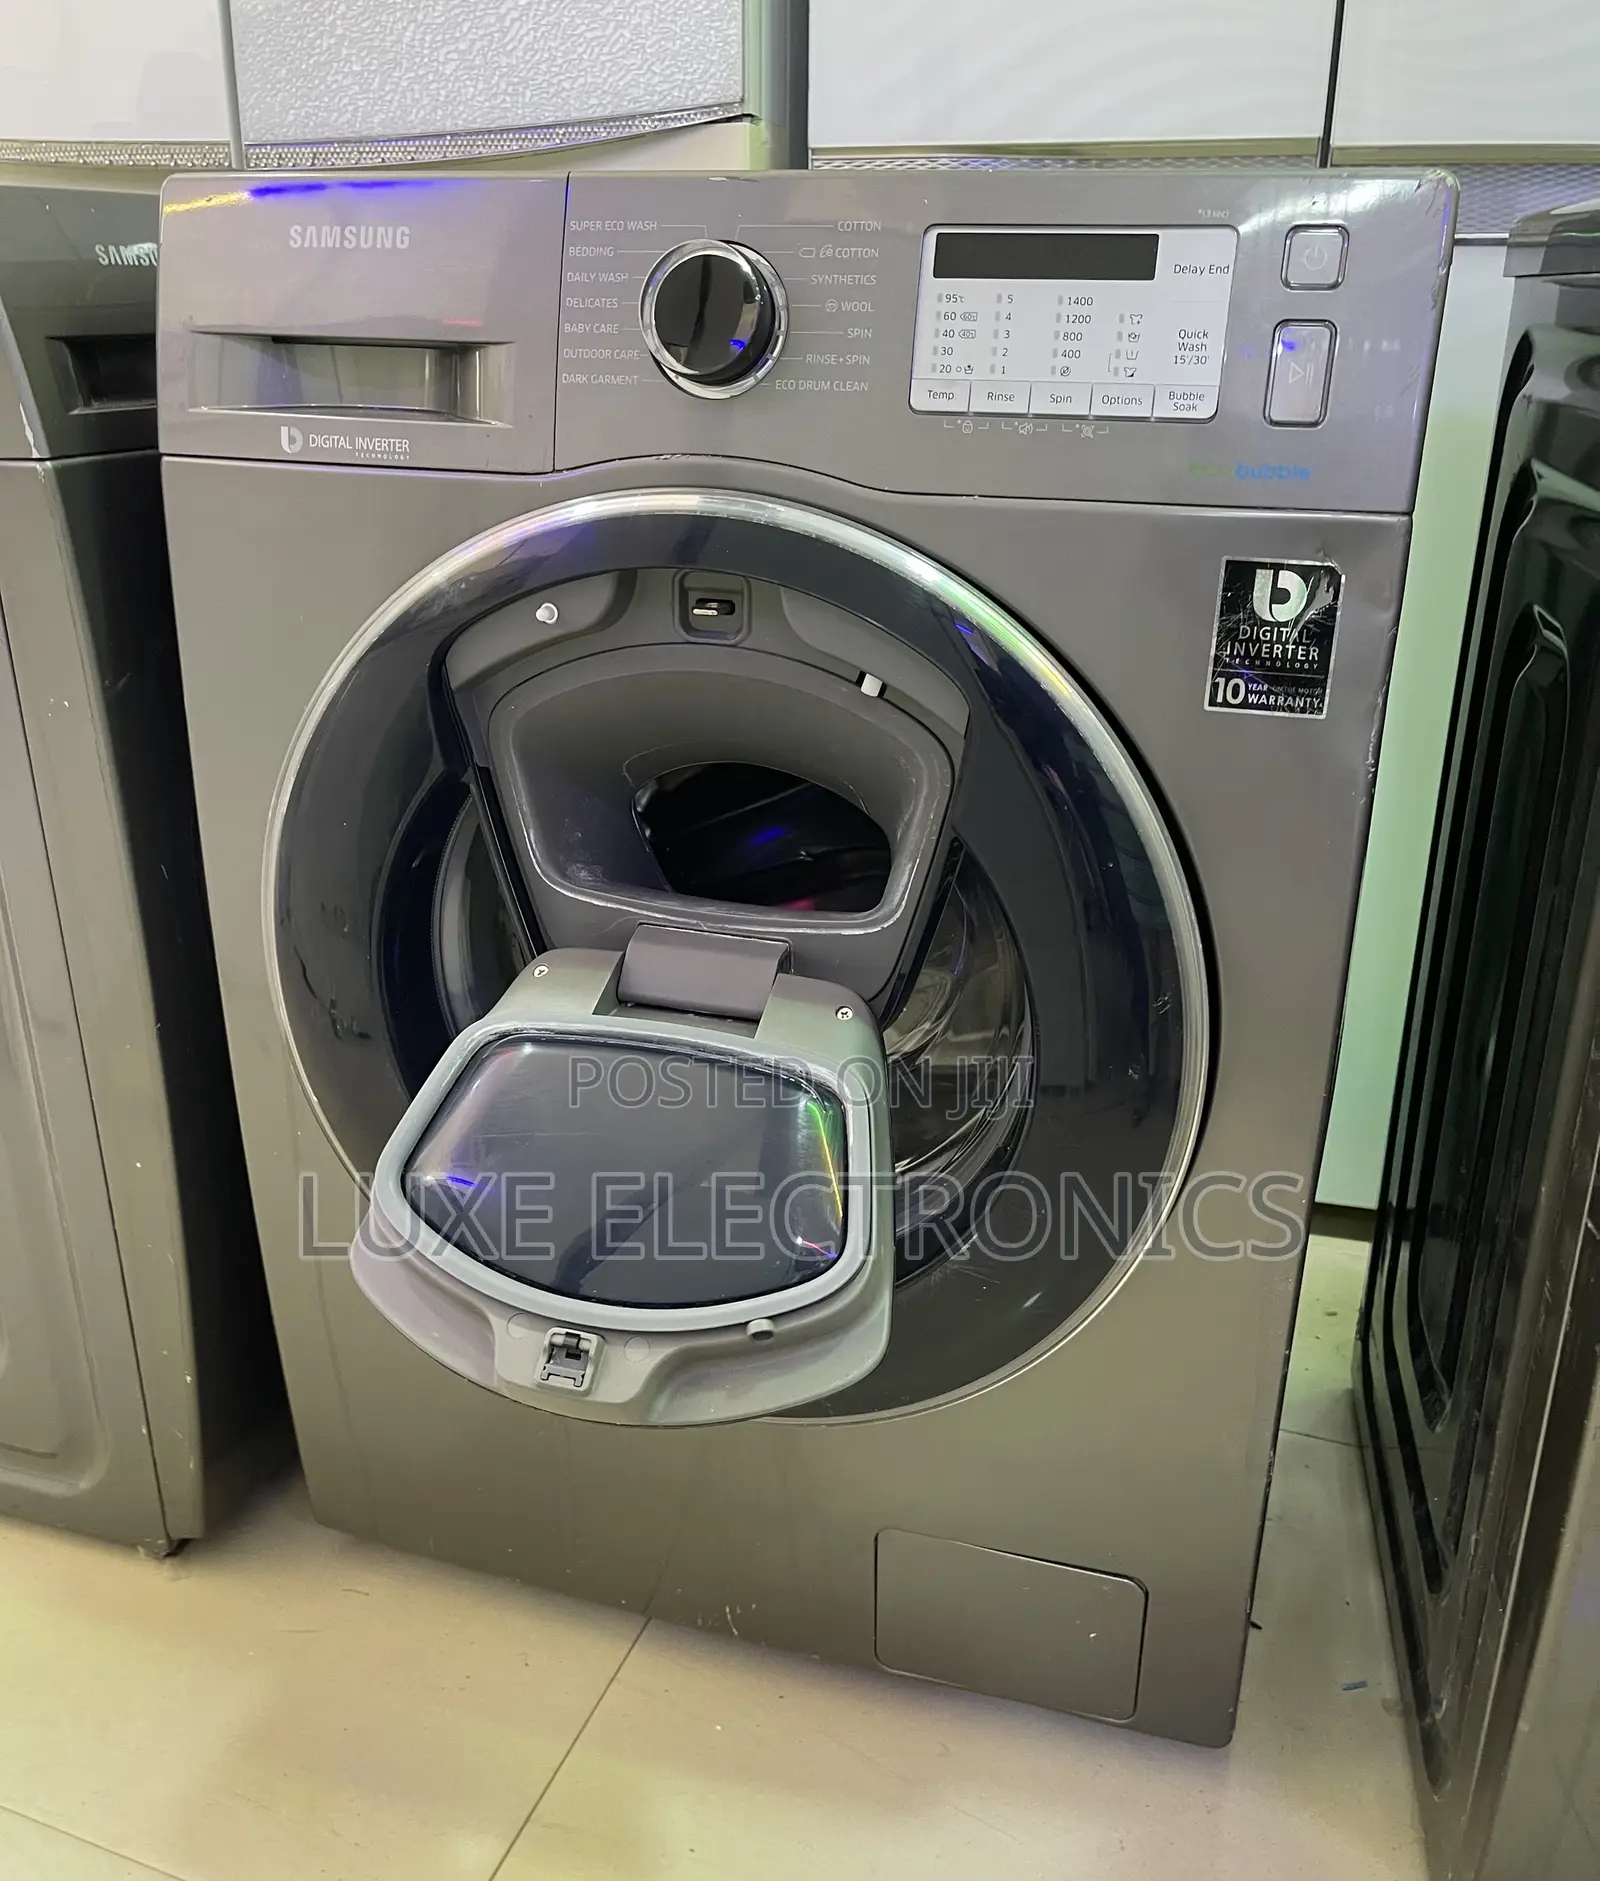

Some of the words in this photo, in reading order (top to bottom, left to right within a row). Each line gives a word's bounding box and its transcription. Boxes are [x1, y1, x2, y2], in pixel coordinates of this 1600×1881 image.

[570, 221, 602, 231] SUPER
[605, 221, 624, 231] ECO
[627, 221, 657, 231] WASH
[838, 221, 881, 231] COTTON
[289, 225, 410, 249] SAMSUNG
[569, 247, 614, 257] BEDDING
[835, 248, 879, 258] COTTON
[1173, 264, 1205, 275] Delay
[1209, 264, 1229, 274] End
[567, 273, 596, 282] DAILY
[599, 273, 628, 282] WASH
[811, 275, 877, 285] SYNTHETICS
[566, 298, 618, 308] DELICATES
[1007, 294, 1014, 303] 5
[1067, 296, 1093, 306] 1400
[841, 302, 874, 312] WOOL
[943, 312, 957, 321] 60
[1005, 312, 1012, 321] 4
[1065, 314, 1091, 324] 1200
[564, 323, 591, 333] BABY
[593, 324, 619, 333] CARE
[847, 328, 872, 338] SPIN
[942, 329, 955, 339] 40
[1004, 330, 1010, 339] 3
[1062, 332, 1083, 342] 800
[1178, 329, 1209, 340] Quick
[940, 347, 954, 356] 30
[1178, 342, 1207, 351] Wash
[563, 349, 611, 359] OUTDOOR
[614, 350, 640, 359] CARE
[1002, 348, 1009, 357] 2
[1061, 349, 1081, 359] 400
[806, 354, 870, 365] RINSE+SPIN
[939, 364, 952, 374] 20
[1001, 366, 1006, 375] 1
[562, 374, 589, 384] DARK
[591, 375, 638, 385] GARMENT
[775, 380, 795, 390] ECO
[798, 380, 831, 391] DRUM
[833, 381, 868, 392] CLEAN
[927, 390, 954, 400] Temp
[987, 391, 1015, 402] Rinse
[1050, 393, 1072, 404] Spin
[1169, 391, 1205, 401] Bubble
[1102, 395, 1142, 407] Options
[1173, 401, 1197, 412] Soak
[309, 434, 352, 449] DIGITAL
[355, 437, 409, 452] INVERTER
[355, 452, 410, 460] TECHNOLOGY
[1238, 625, 1310, 643] DIGITAL
[1226, 641, 1319, 660] INVERTER
[1225, 658, 1318, 669] TECHNOLOGY
[1214, 678, 1245, 705] 10
[1248, 683, 1268, 691] YEAR
[1248, 694, 1320, 708] WARRANTY
